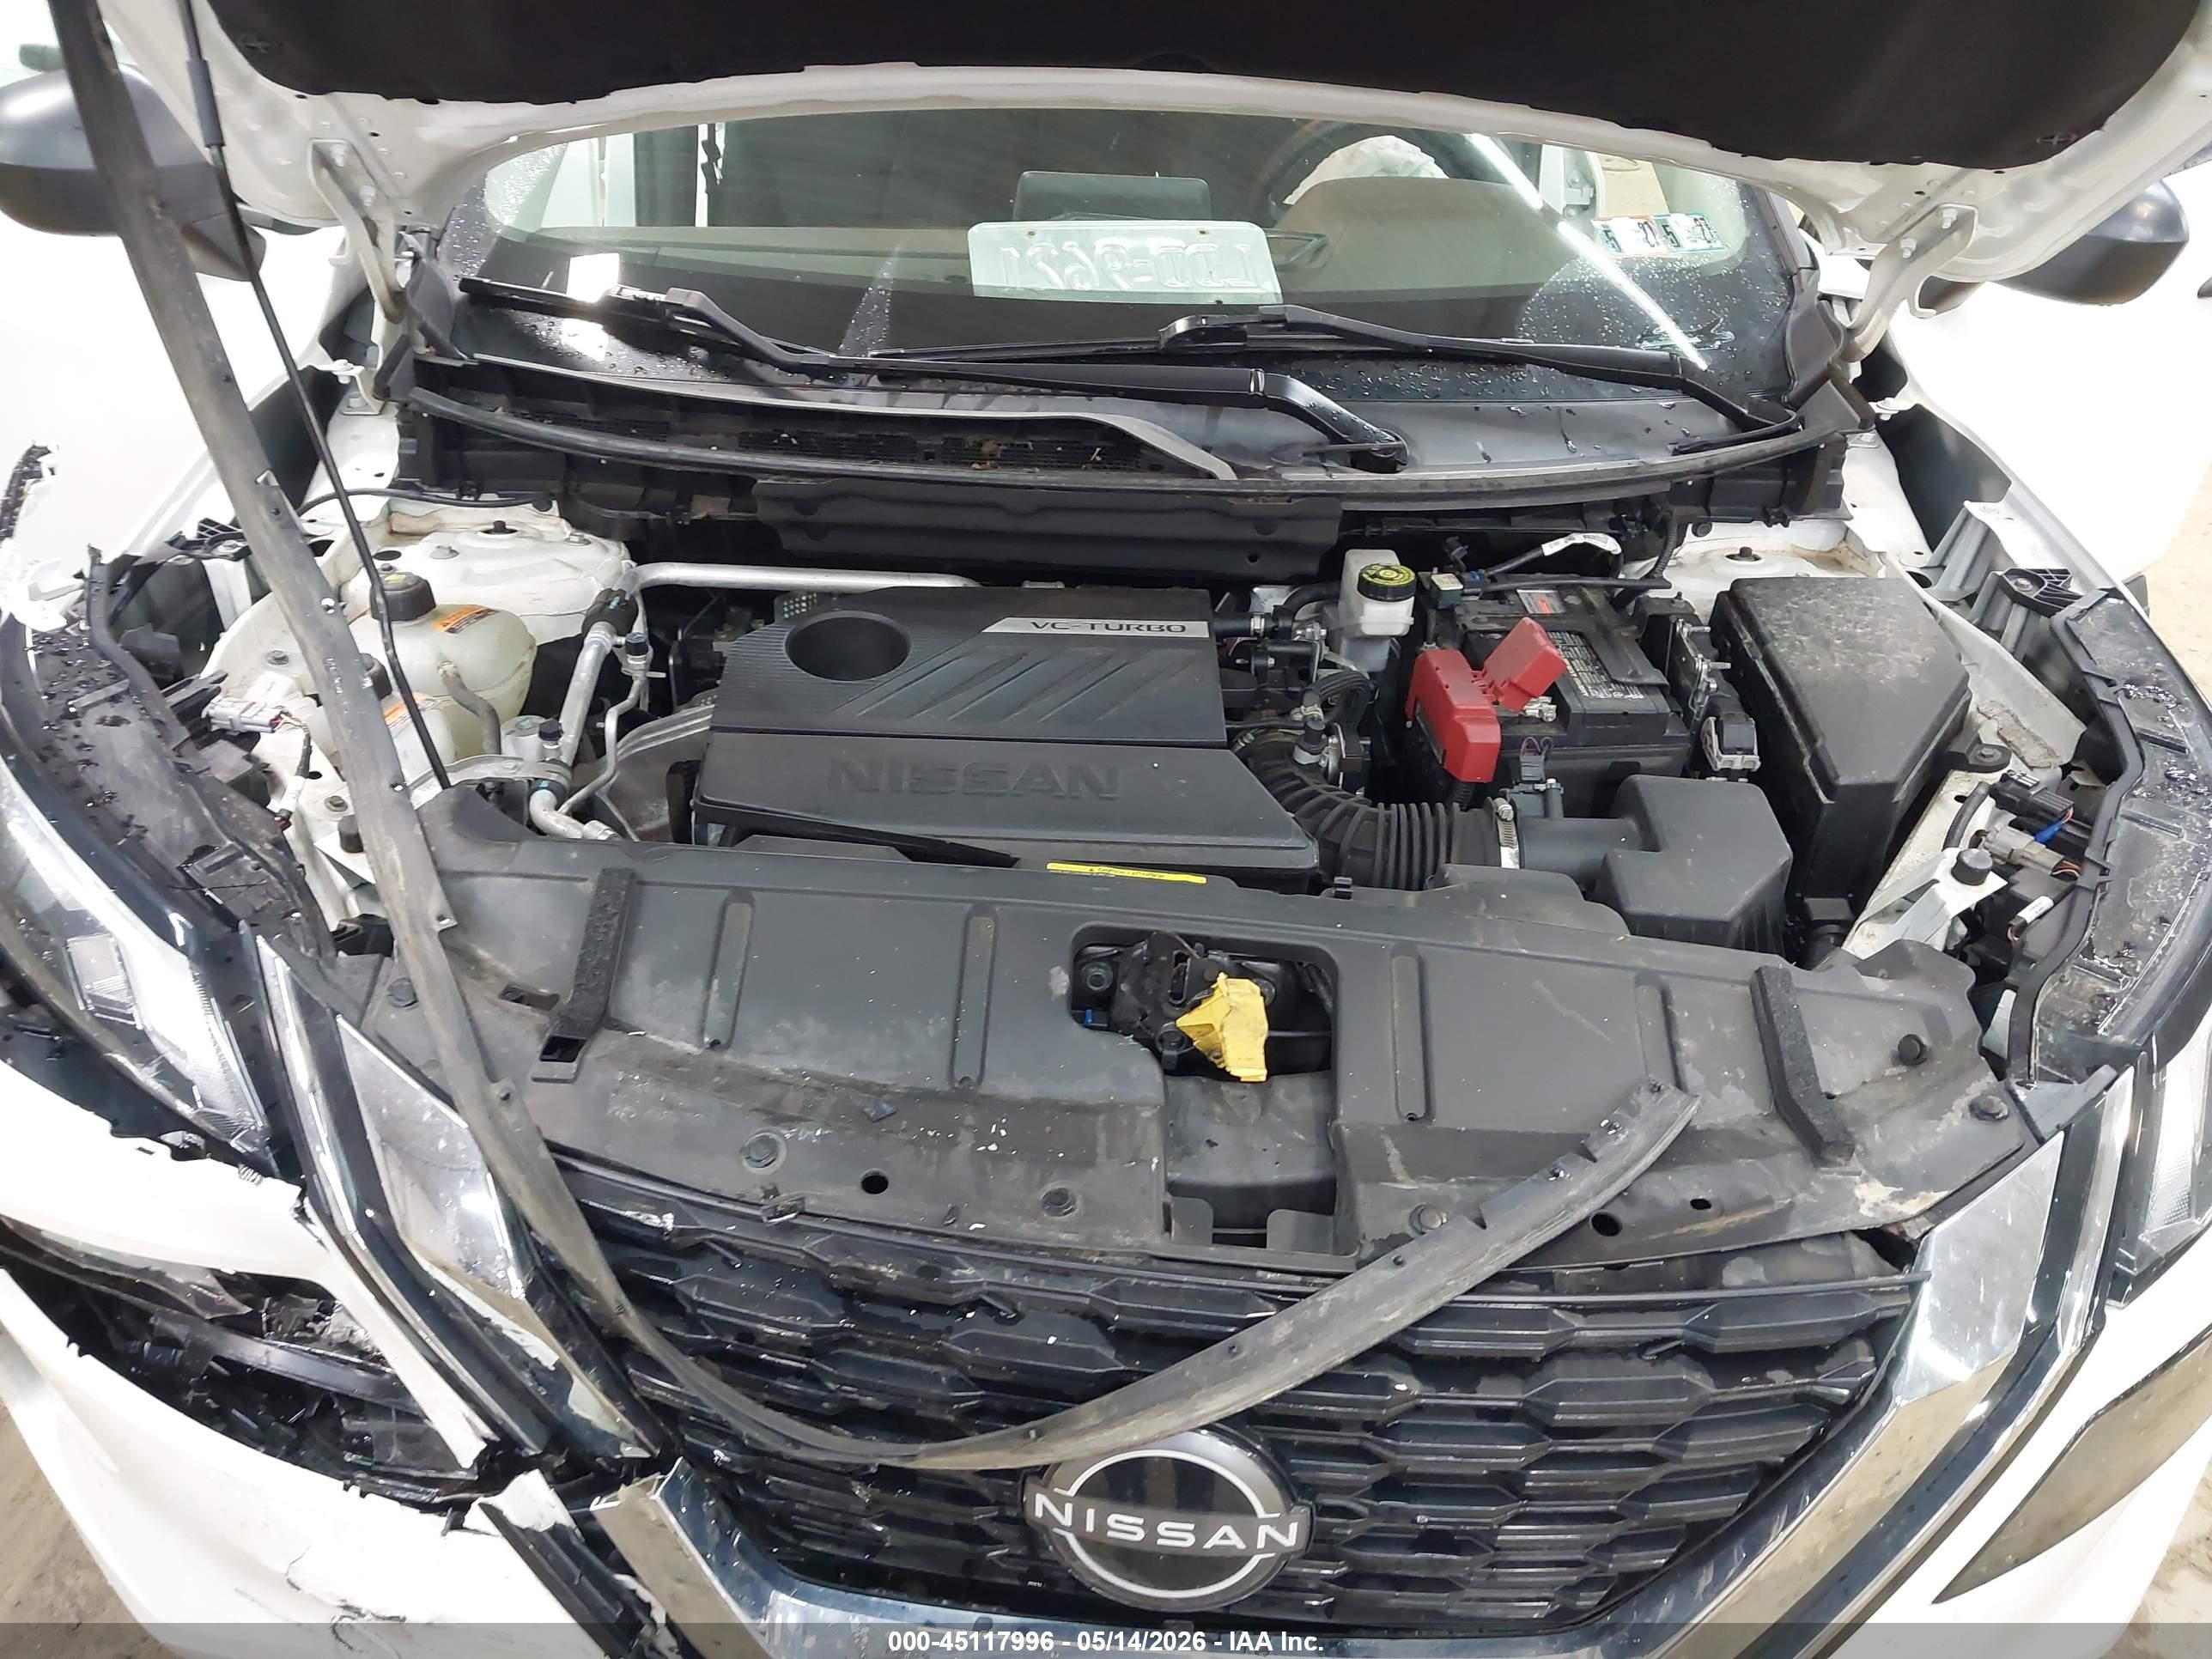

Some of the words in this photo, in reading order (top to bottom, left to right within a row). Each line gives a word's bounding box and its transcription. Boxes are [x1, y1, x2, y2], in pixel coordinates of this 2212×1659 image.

[1662, 225, 1680, 247] 5
[1030, 621, 1187, 634] VC-TURBO
[830, 759, 1120, 800] NISSAN
[1034, 1492, 1299, 1549] NISSAN
